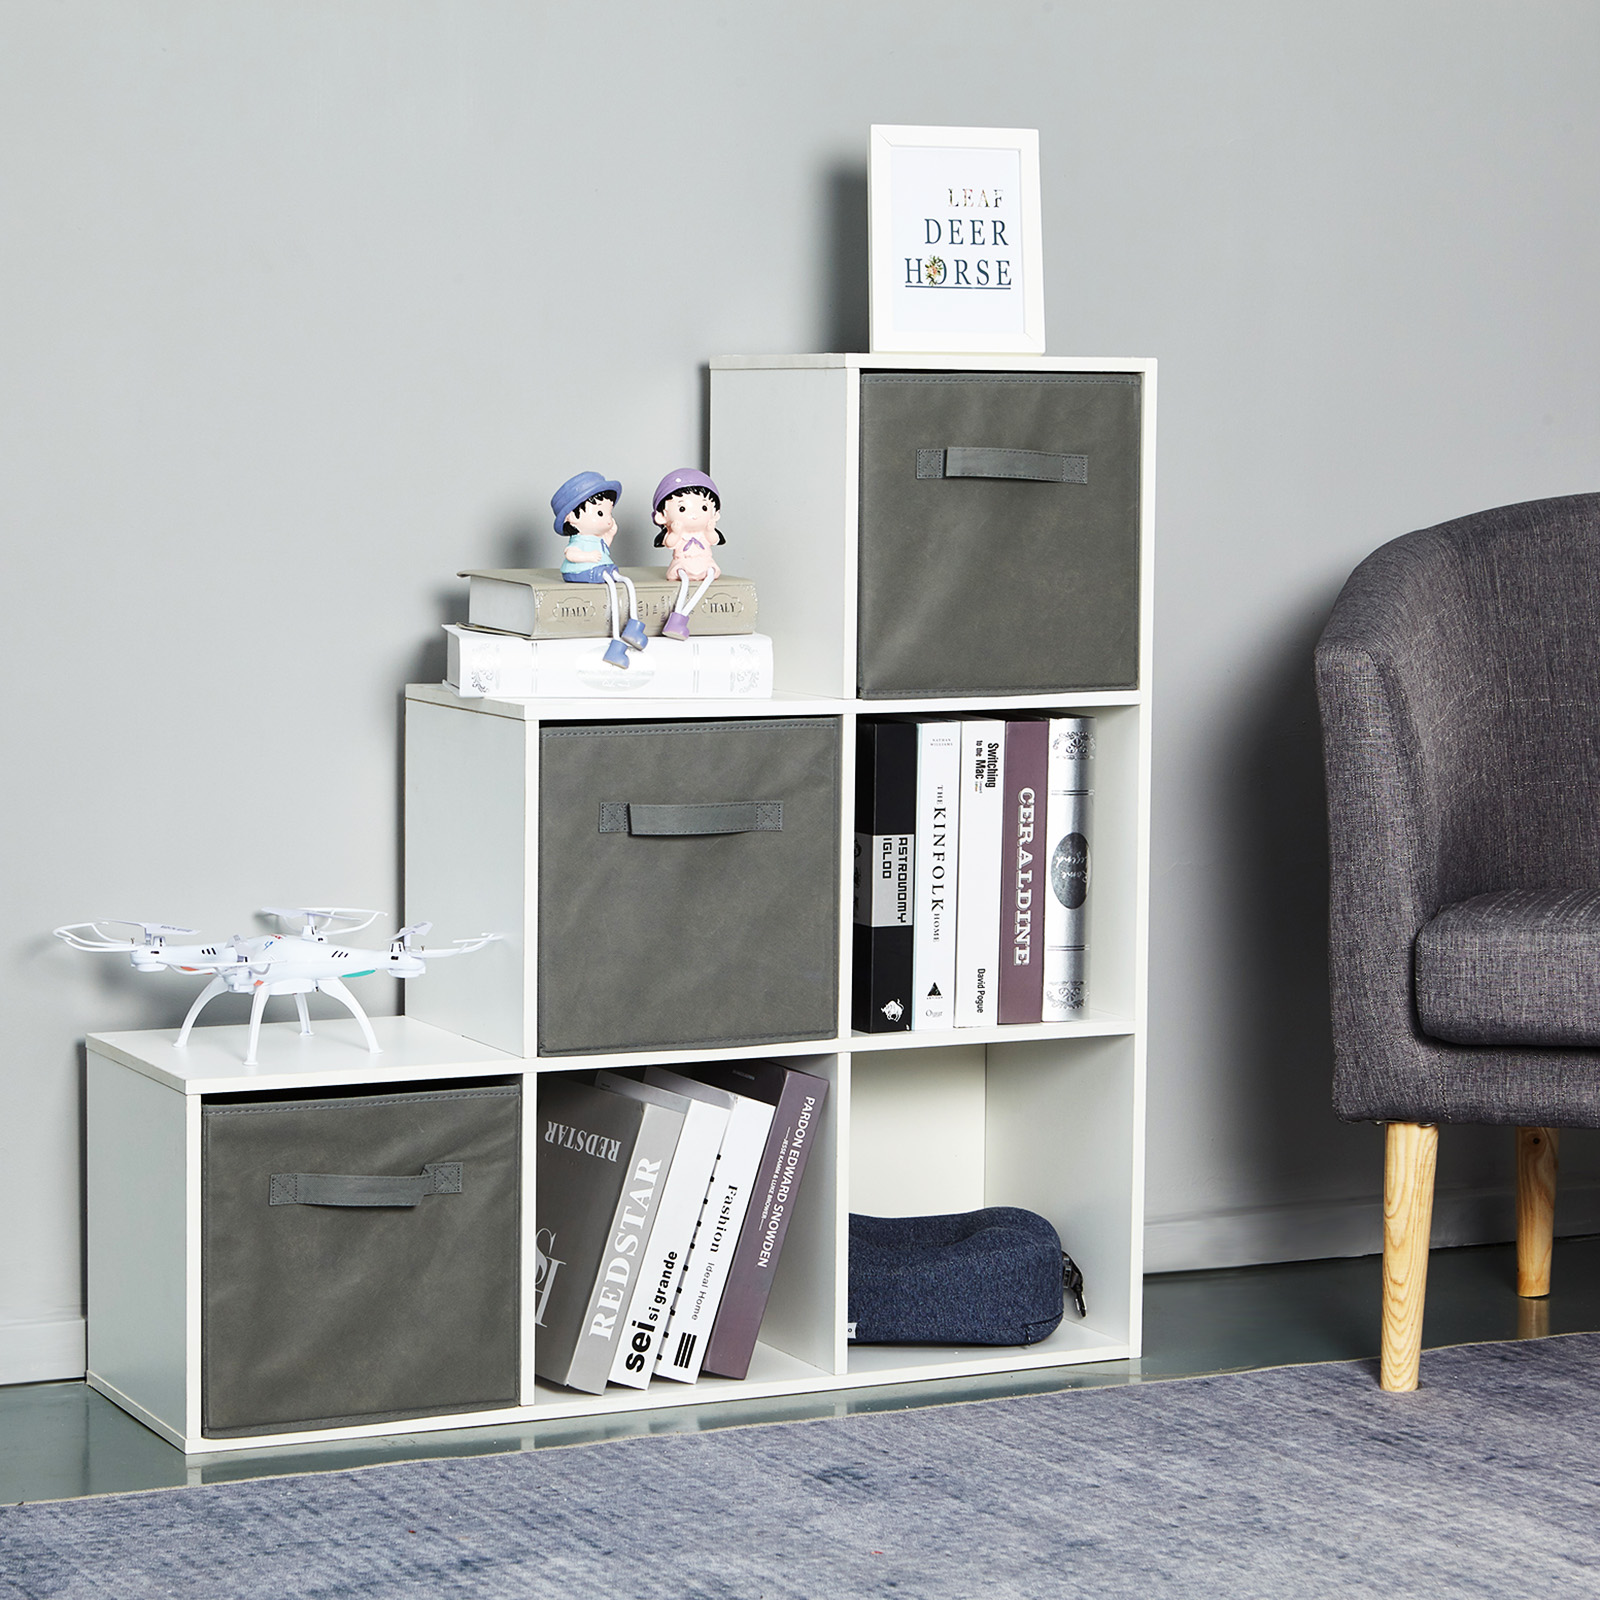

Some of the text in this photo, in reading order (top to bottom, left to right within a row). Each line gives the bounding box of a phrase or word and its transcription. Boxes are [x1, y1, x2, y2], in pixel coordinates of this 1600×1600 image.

[948, 188, 1003, 208] LEAF
[924, 218, 1009, 246] DEER
[904, 257, 1012, 286] HORSE
[561, 606, 588, 617] ITALY
[710, 602, 736, 613] ITALY
[975, 760, 986, 779] Mac
[985, 743, 999, 788] Switching
[882, 838, 892, 879] IGLOO
[897, 837, 908, 923] ASTRONOMY
[931, 807, 946, 911] KINFOLK
[1014, 787, 1036, 966] CERALDINE
[975, 968, 986, 1013] David Pogue
[544, 1121, 622, 1163] REDSTAR
[757, 1096, 816, 1268] PARDON EDWARD SNOWDEN
[588, 1156, 663, 1341] REDSTAR
[691, 1184, 738, 1321] Fashion Ideal Home
[625, 1250, 678, 1373] sei si grande
